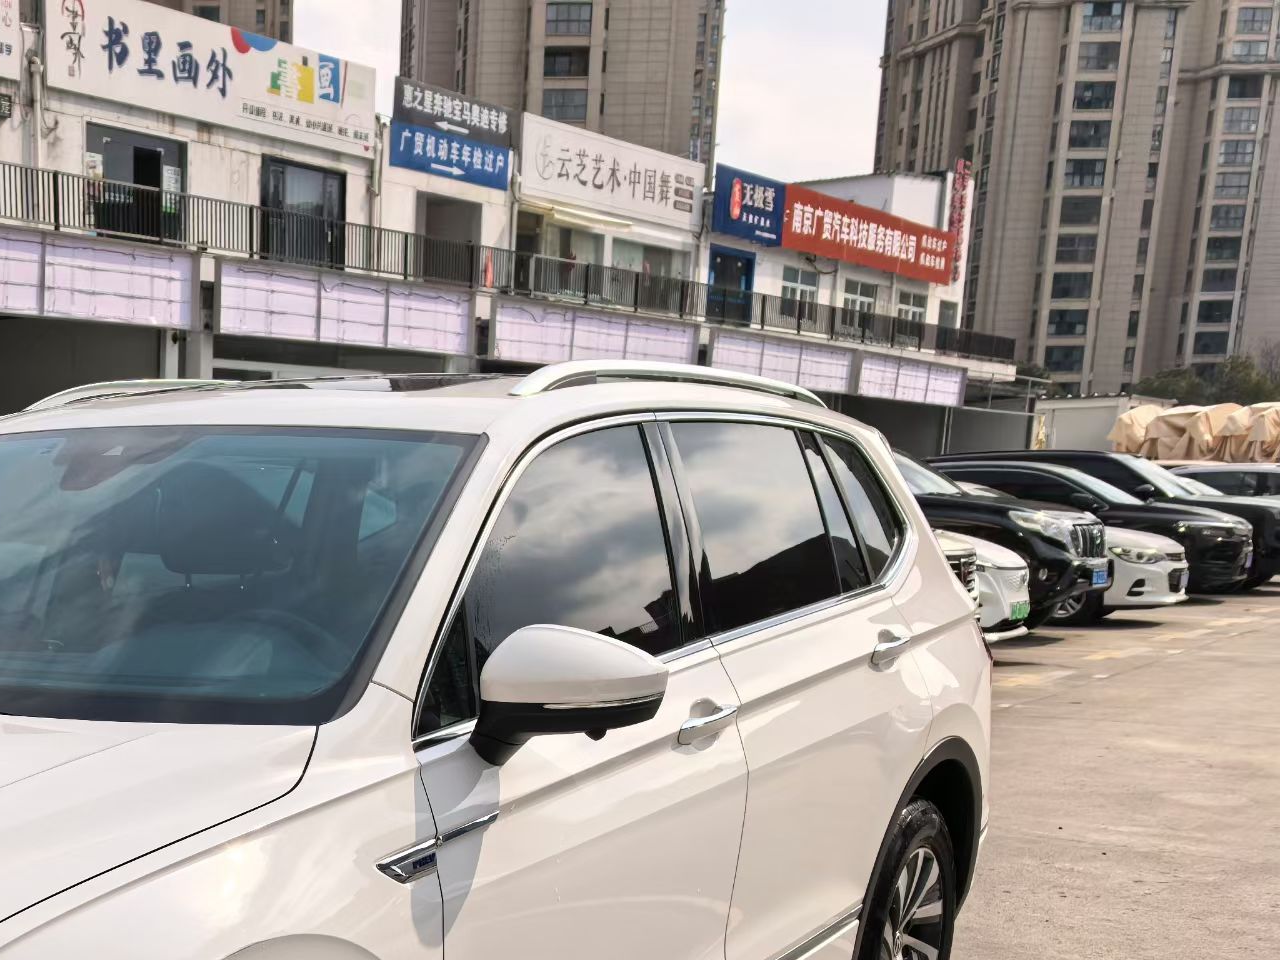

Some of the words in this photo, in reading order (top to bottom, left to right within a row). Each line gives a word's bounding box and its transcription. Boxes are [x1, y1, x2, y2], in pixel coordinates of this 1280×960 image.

[101, 15, 234, 99] 书里画外
[399, 128, 505, 174] 广贸机动车年检过户
[791, 201, 918, 263] 南京广贸汽车科技服务有限公司
